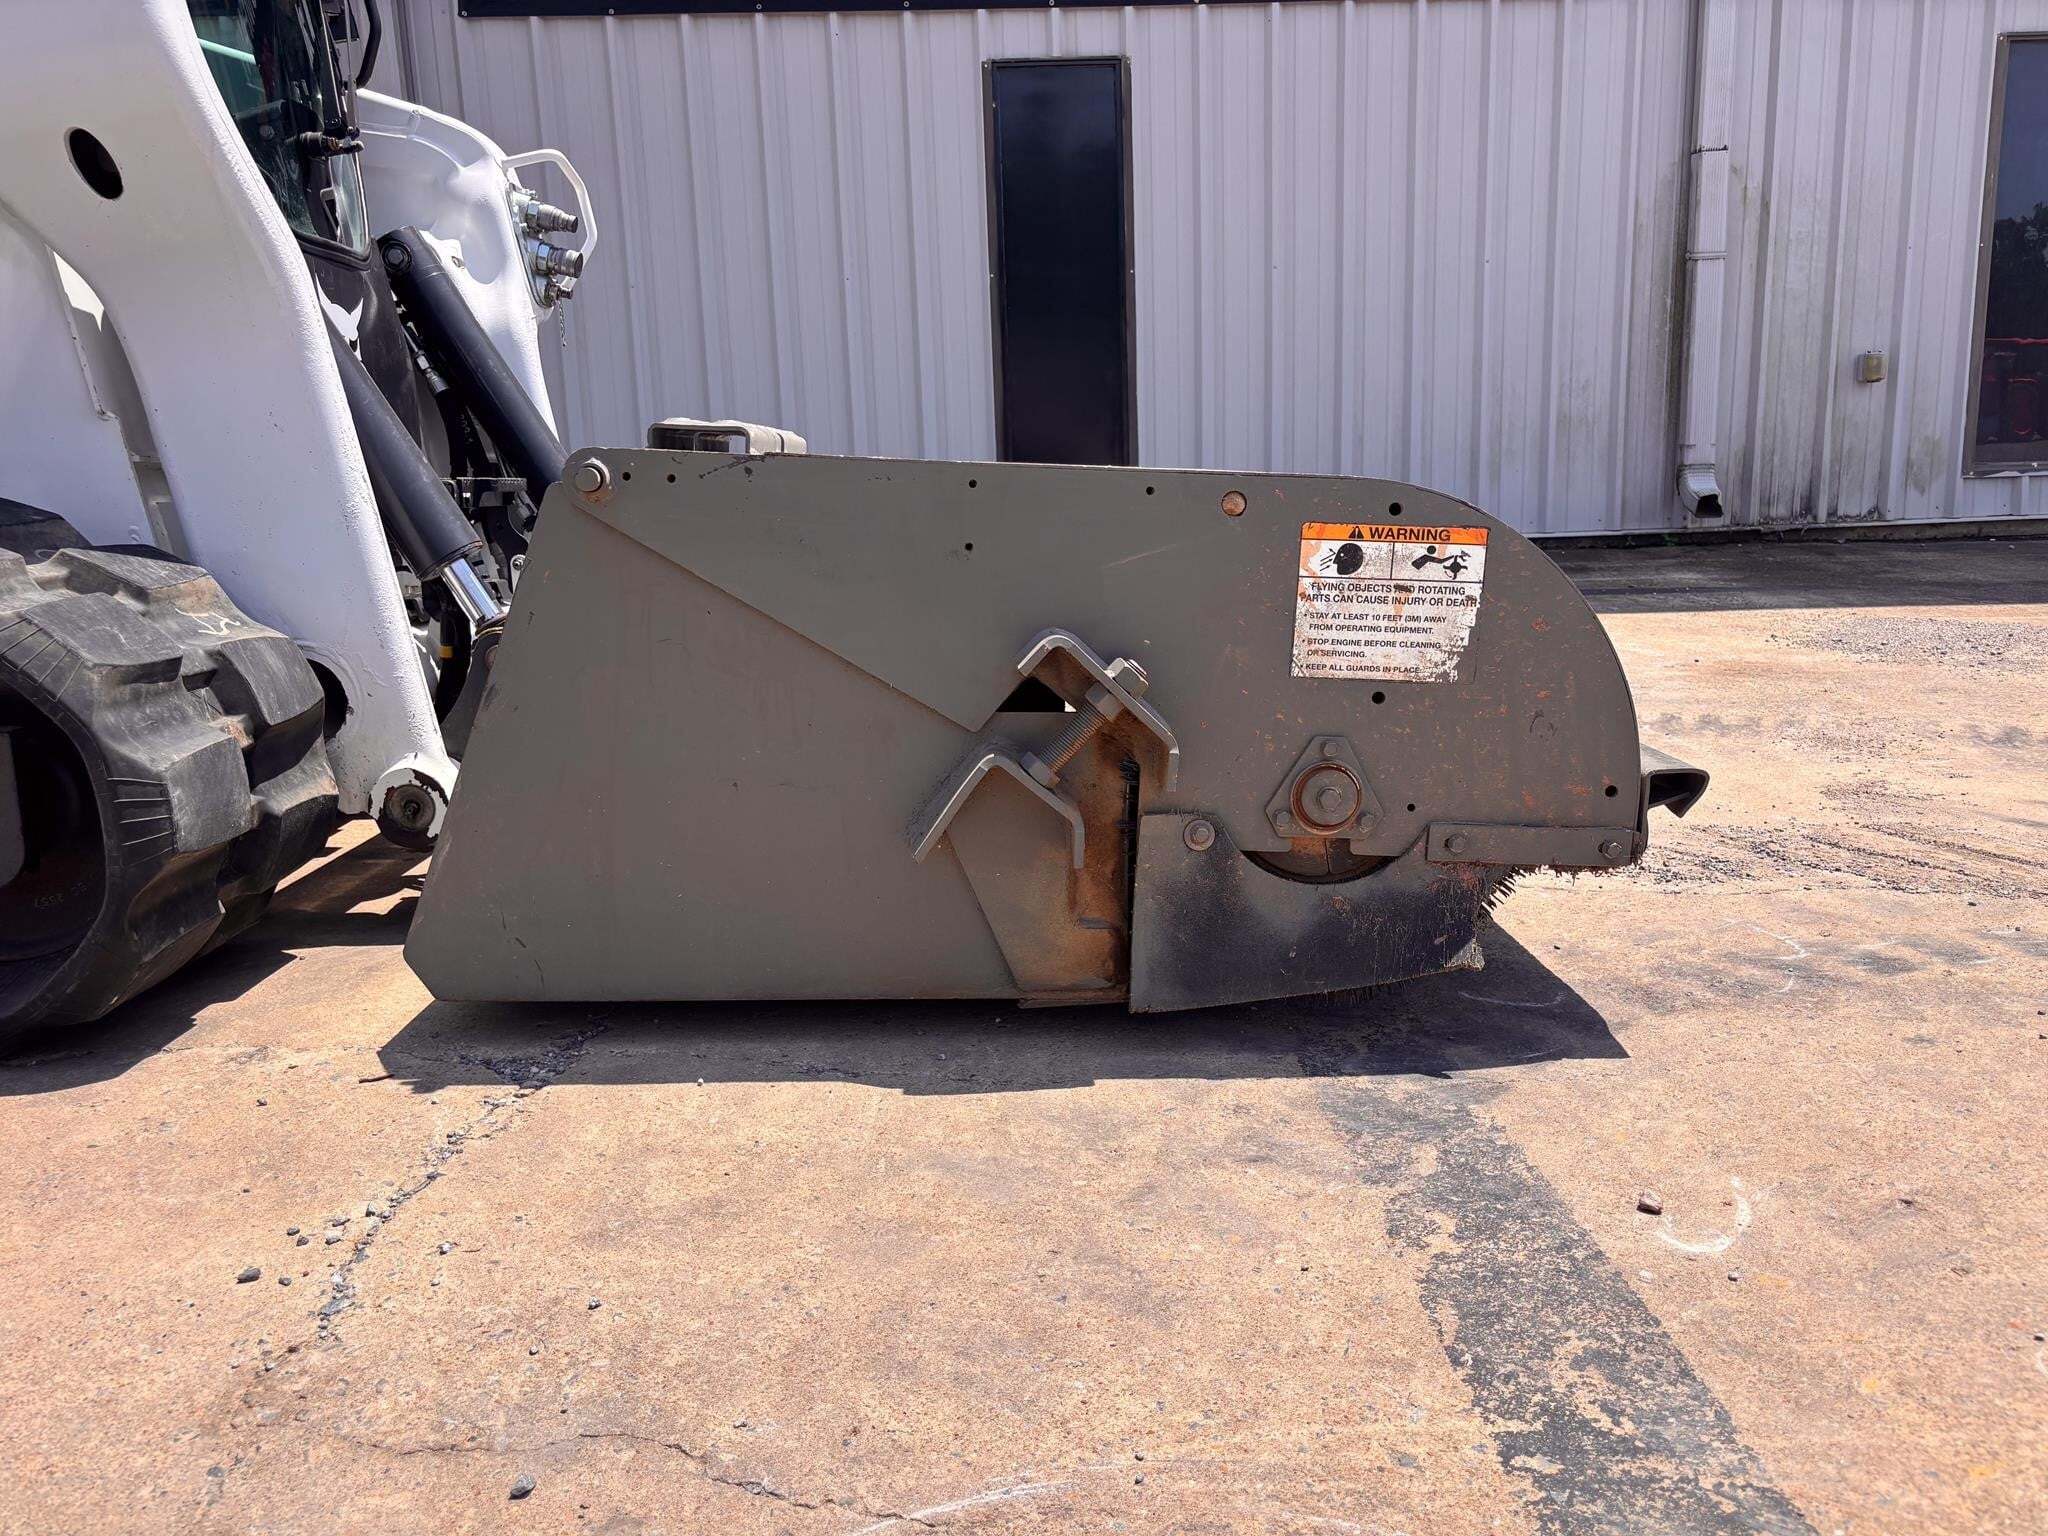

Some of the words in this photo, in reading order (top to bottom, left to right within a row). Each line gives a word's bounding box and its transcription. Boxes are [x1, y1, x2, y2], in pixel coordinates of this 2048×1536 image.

[1370, 527, 1451, 541] WARNING
[1311, 582, 1345, 591] FLYING
[1347, 583, 1392, 593] OBJECTS
[1417, 585, 1466, 596] ROTATING
[1299, 593, 1331, 603] PARTS
[1333, 594, 1354, 603] CAN
[1356, 595, 1389, 605] CAUSE
[1391, 596, 1427, 606] INJURY
[1429, 597, 1443, 606] OR
[1331, 612, 1342, 620] AT
[1343, 613, 1369, 621] LEAST
[1382, 614, 1403, 622] FEET
[1404, 615, 1422, 623] (3M)
[1335, 624, 1382, 633] OPERATING
[1384, 626, 1434, 635] EQUIPMENT.
[1330, 638, 1362, 646] ENGINE
[1363, 639, 1397, 647] BEFORE
[1398, 640, 1441, 649] CLEANING
[1307, 649, 1319, 657] OR
[1320, 649, 1367, 658] SERVICING.
